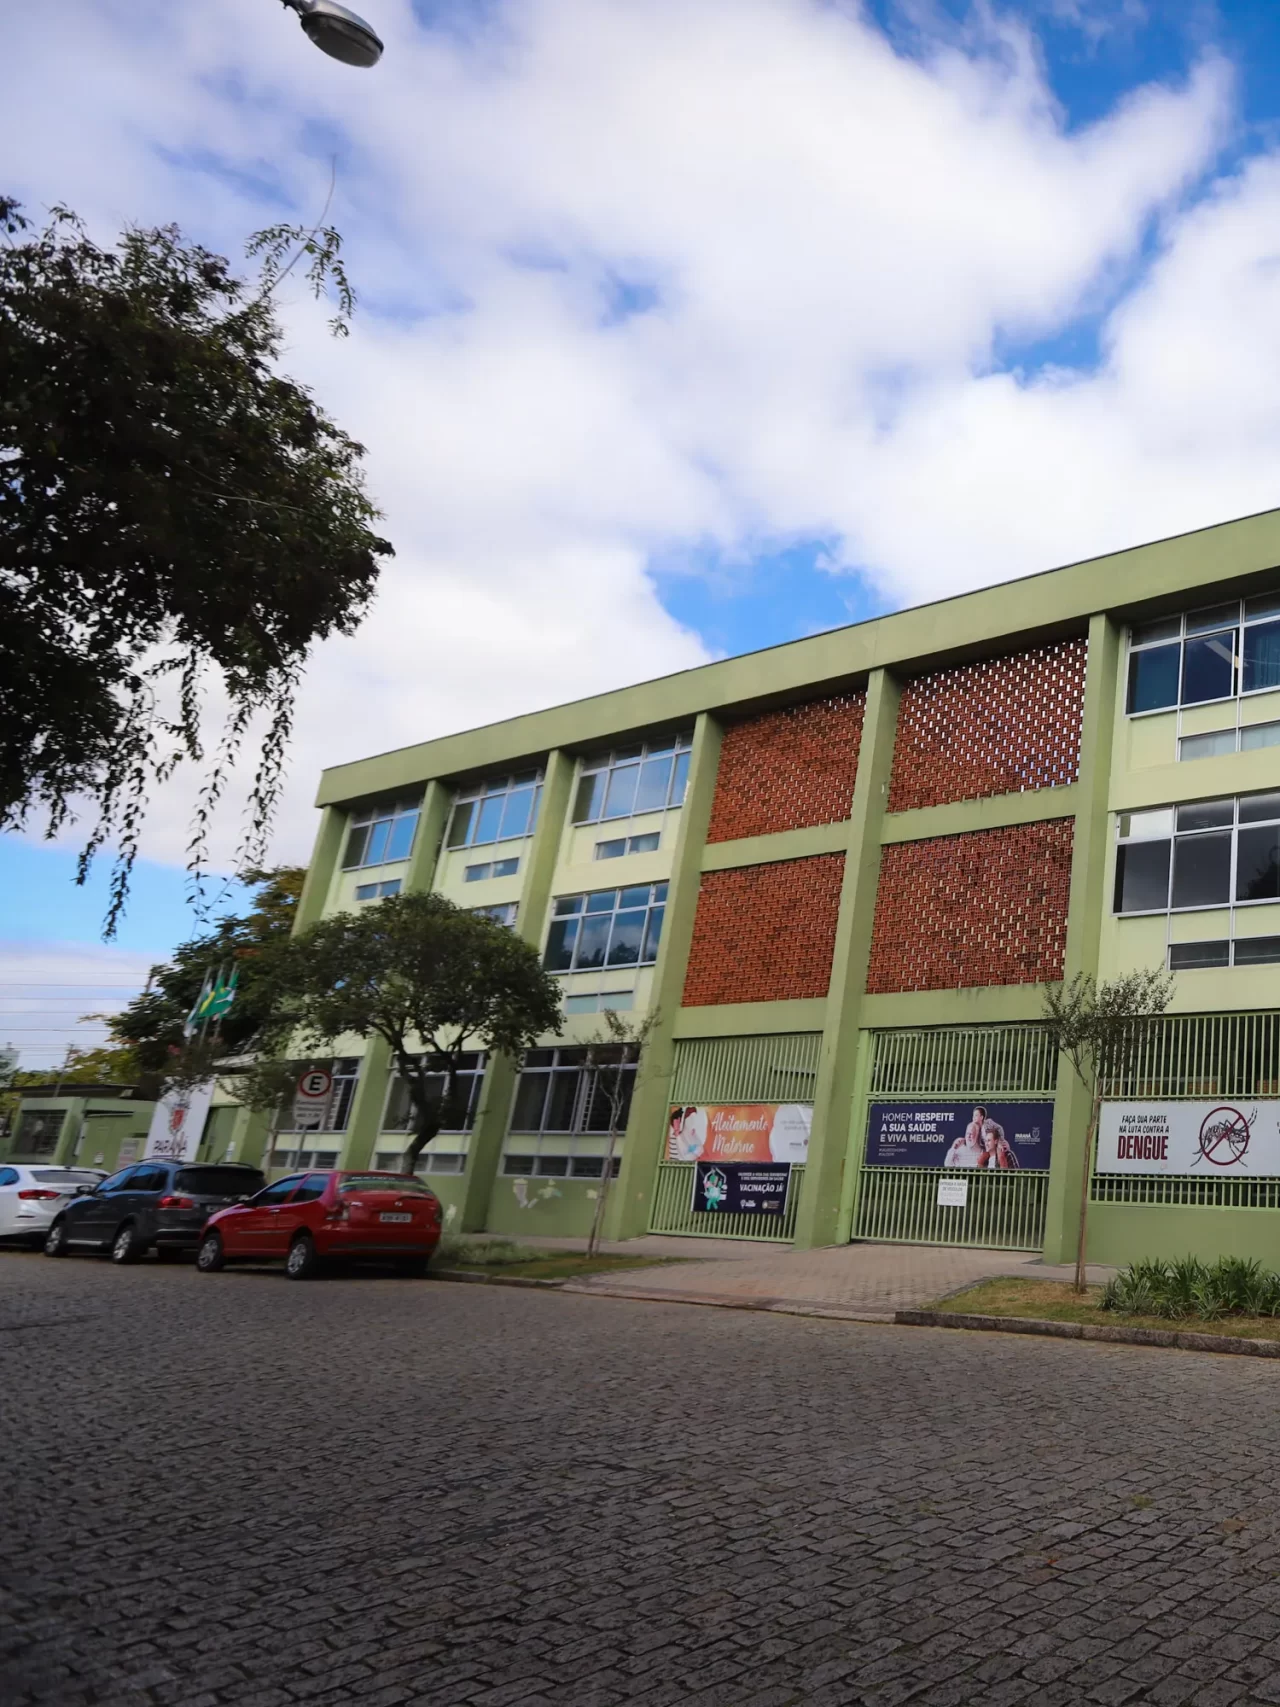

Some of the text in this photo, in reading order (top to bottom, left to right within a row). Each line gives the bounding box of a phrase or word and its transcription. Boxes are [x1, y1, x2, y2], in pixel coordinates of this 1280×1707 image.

[309, 1076, 323, 1090] E
[711, 1112, 768, 1131] Aleitamento
[882, 1113, 954, 1121] HOMEM RESPEITE
[1122, 1115, 1167, 1125] FAÇA SUA PARTE
[881, 1122, 937, 1132] A SUA SAÚDE
[1165, 1125, 1169, 1133] A
[712, 1134, 754, 1153] Materno
[880, 1134, 944, 1143] E VIVA MELHOR
[1117, 1135, 1169, 1160] DENGUE
[740, 1182, 785, 1194] VACINAÇÃO JÁ
